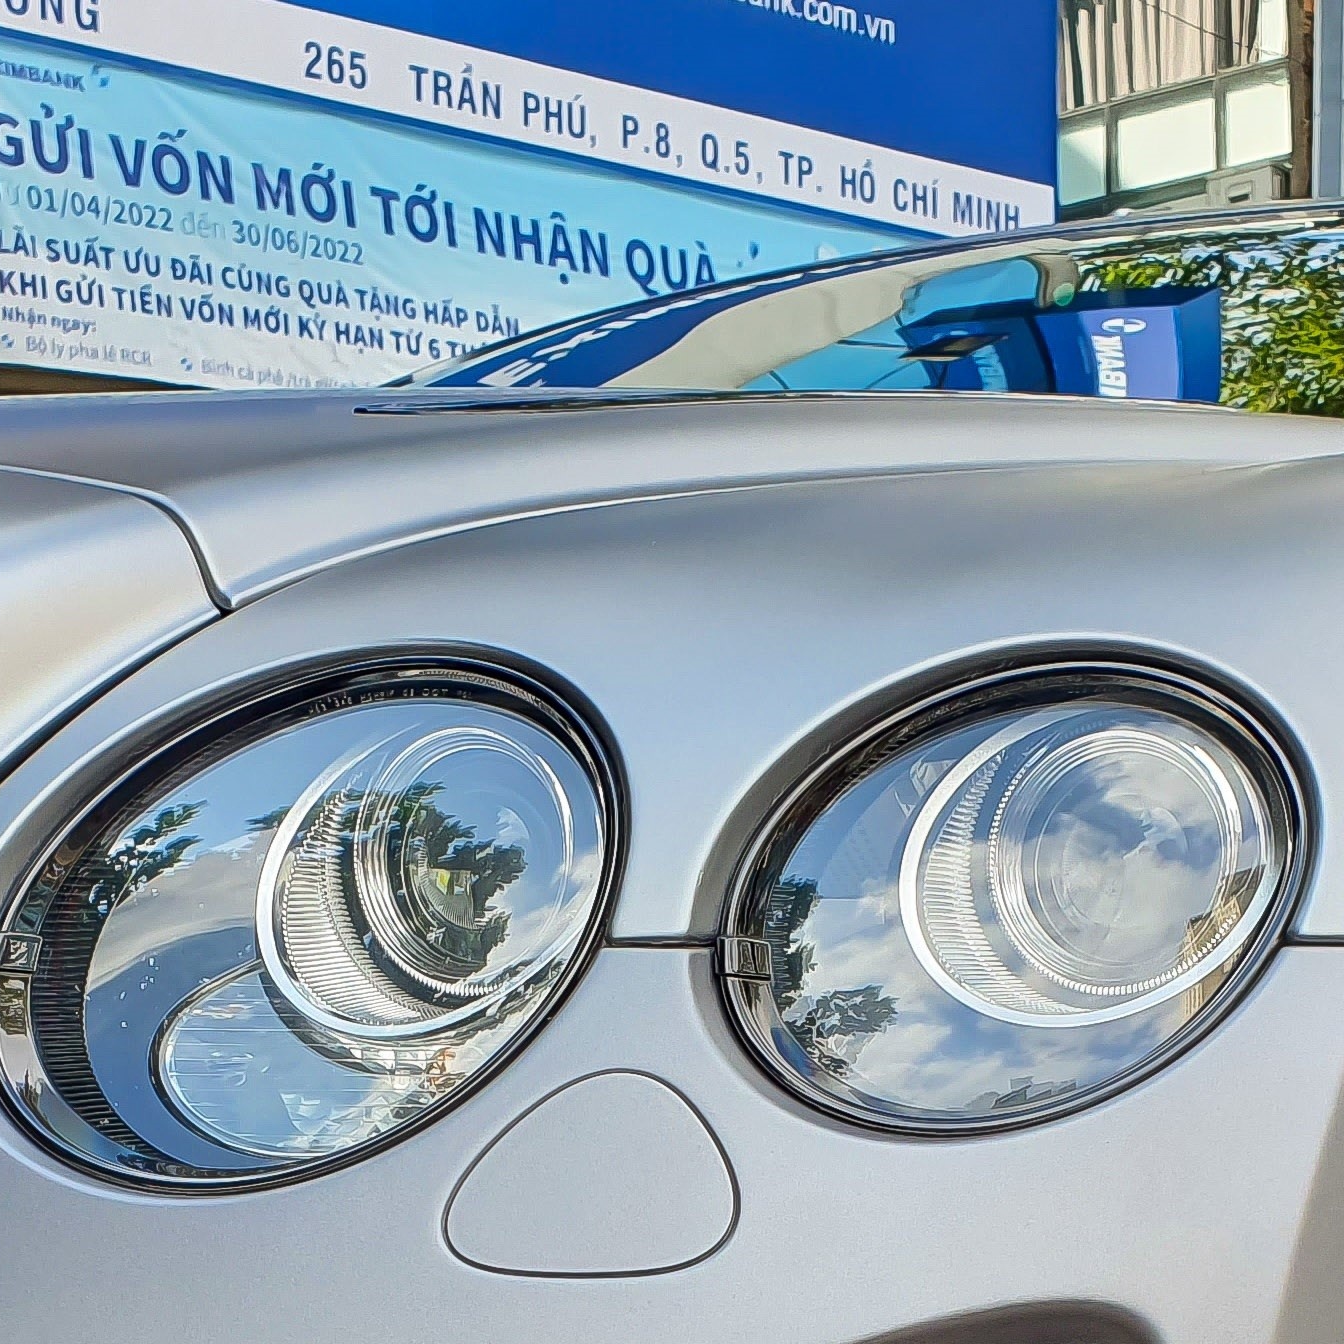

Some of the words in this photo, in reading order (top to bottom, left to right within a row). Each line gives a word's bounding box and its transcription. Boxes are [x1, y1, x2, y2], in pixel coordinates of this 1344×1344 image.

[304, 41, 367, 90] 265
[409, 62, 502, 120] TRẦN
[522, 91, 598, 149] PHÚ,
[622, 113, 683, 168] P.8,
[701, 133, 763, 184] Q.5,
[778, 150, 823, 193] TP.
[840, 158, 876, 204] HỒ
[893, 177, 939, 220] CHÍ
[952, 190, 1021, 233] MINH
[26, 185, 174, 232] 01/04/2022
[232, 219, 364, 265] 30/06/2022
[108, 128, 234, 206] VỐN
[251, 162, 356, 228] MỚI
[369, 183, 458, 248] TỚI
[473, 206, 609, 284] NHẬN
[625, 239, 715, 296] QUÀ
[55, 273, 105, 308] GỬI
[242, 305, 290, 336] MỚI
[335, 321, 384, 354] HẠN
[428, 338, 441, 360] 6
[123, 246, 161, 278] ƯU
[170, 254, 212, 286] ĐÃI
[298, 276, 350, 309] QUÀ
